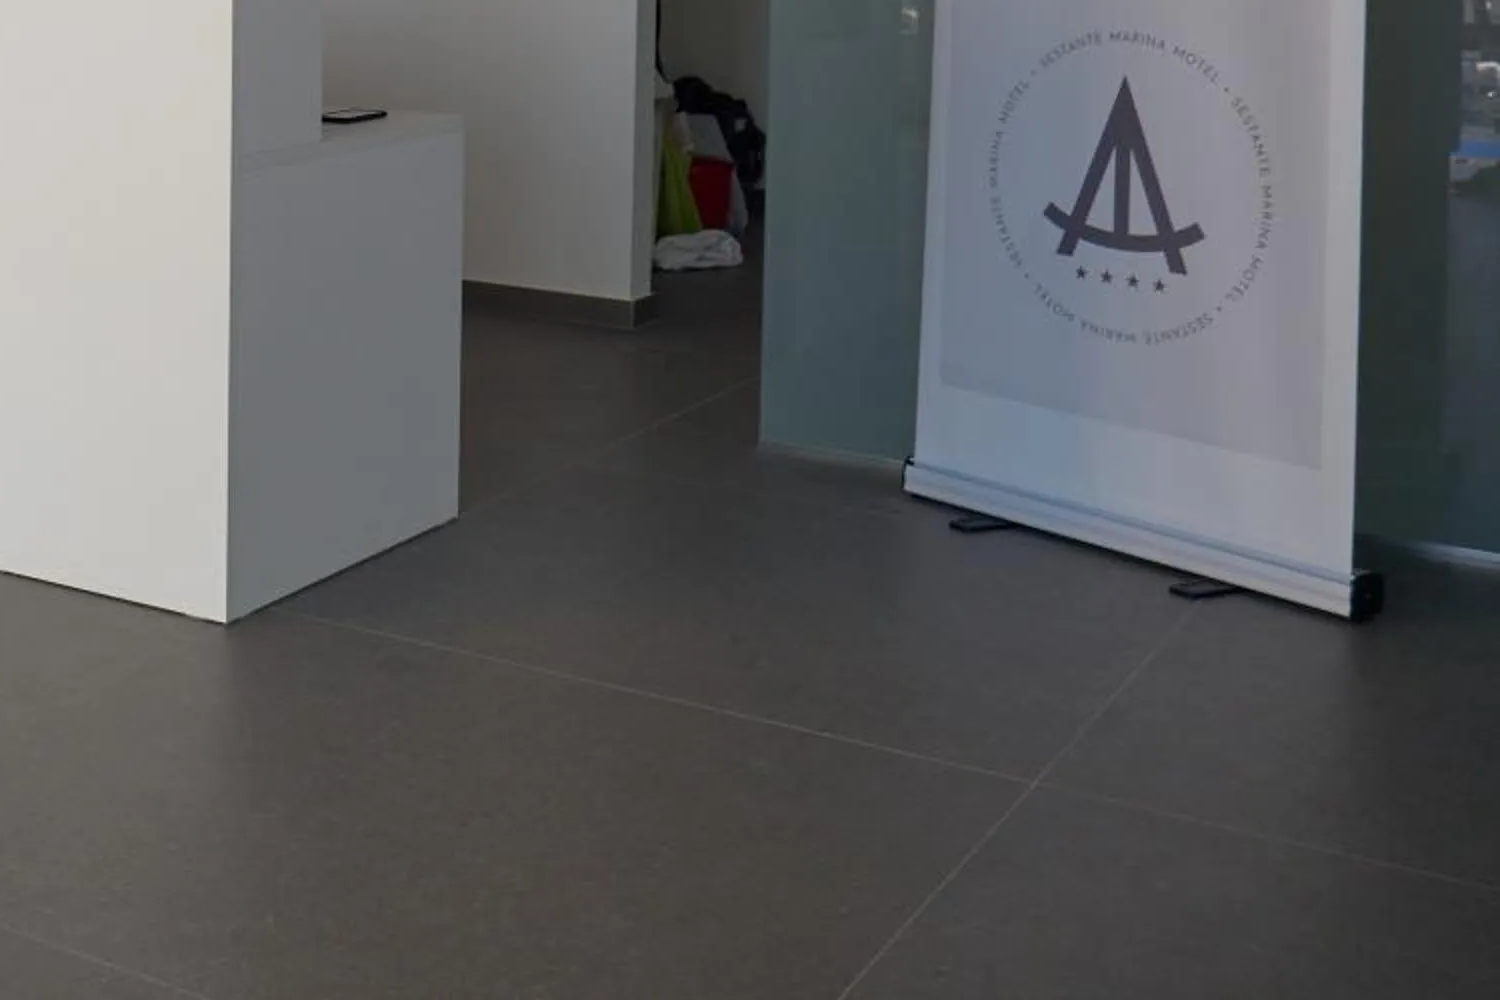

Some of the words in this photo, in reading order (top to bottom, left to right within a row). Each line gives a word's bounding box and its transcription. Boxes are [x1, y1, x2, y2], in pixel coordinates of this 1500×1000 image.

[1039, 30, 1101, 68] SESTANTE
[1108, 30, 1166, 50] MARINA
[1172, 44, 1220, 84] MOTEL
[997, 79, 1030, 125] MOTEL
[1231, 97, 1271, 177] SESTANTE
[1255, 185, 1274, 250] MARINA
[1224, 254, 1264, 302] MOTEL
